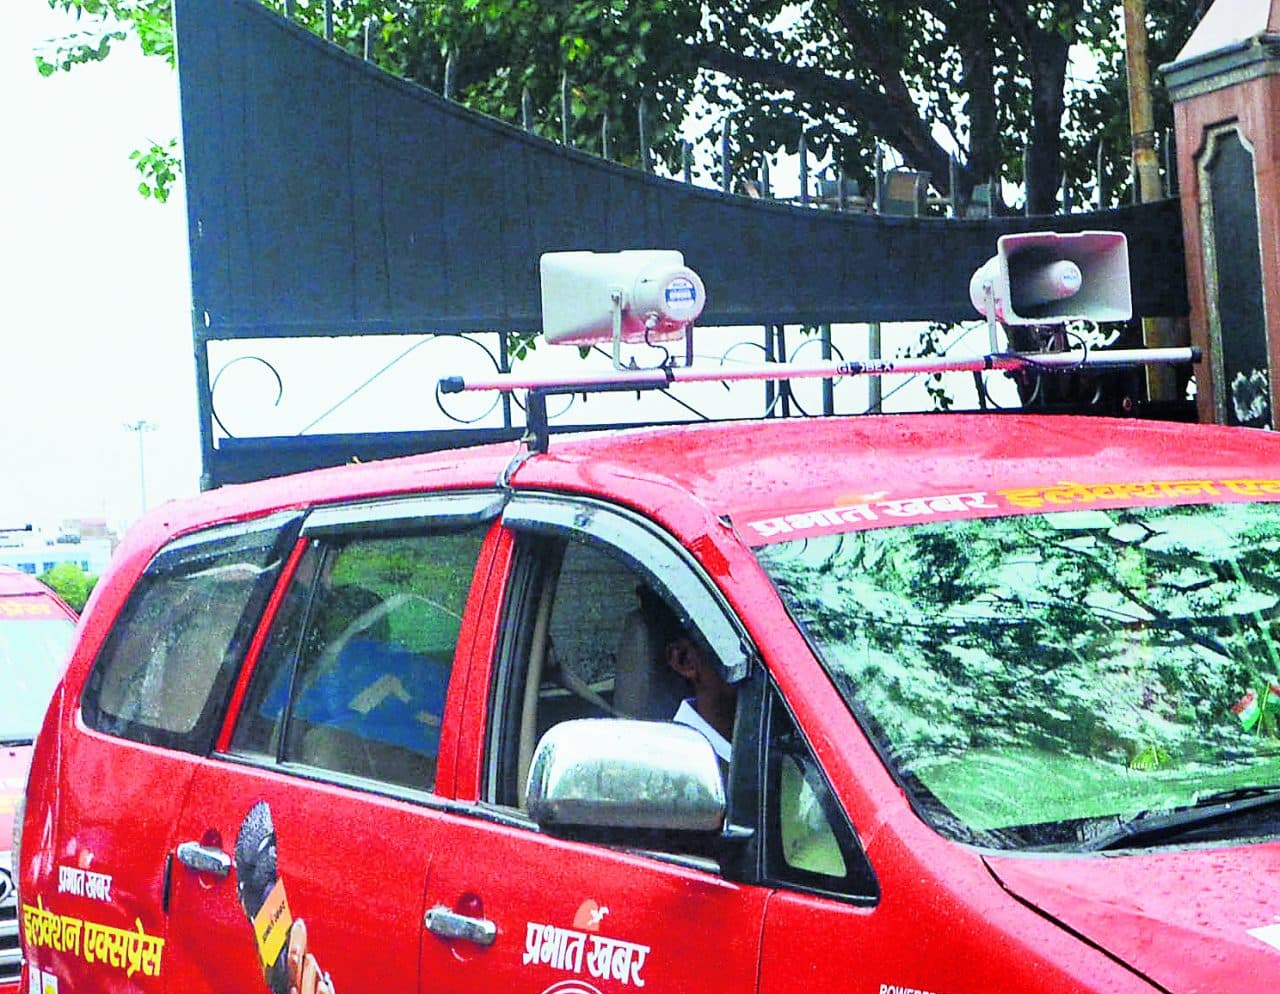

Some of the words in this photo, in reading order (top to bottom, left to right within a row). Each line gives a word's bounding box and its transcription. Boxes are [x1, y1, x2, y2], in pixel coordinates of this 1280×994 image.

[747, 503, 879, 537] प्रभात
[876, 491, 999, 517] खबर
[995, 481, 1224, 509] इलेक्शन
[58, 865, 86, 897] प्रभात
[85, 871, 112, 902] खबर
[22, 893, 82, 956] इलेक्शन
[82, 917, 165, 978] एक्सप्रेस
[522, 921, 588, 974] प्रभात
[586, 933, 651, 988] खबर
